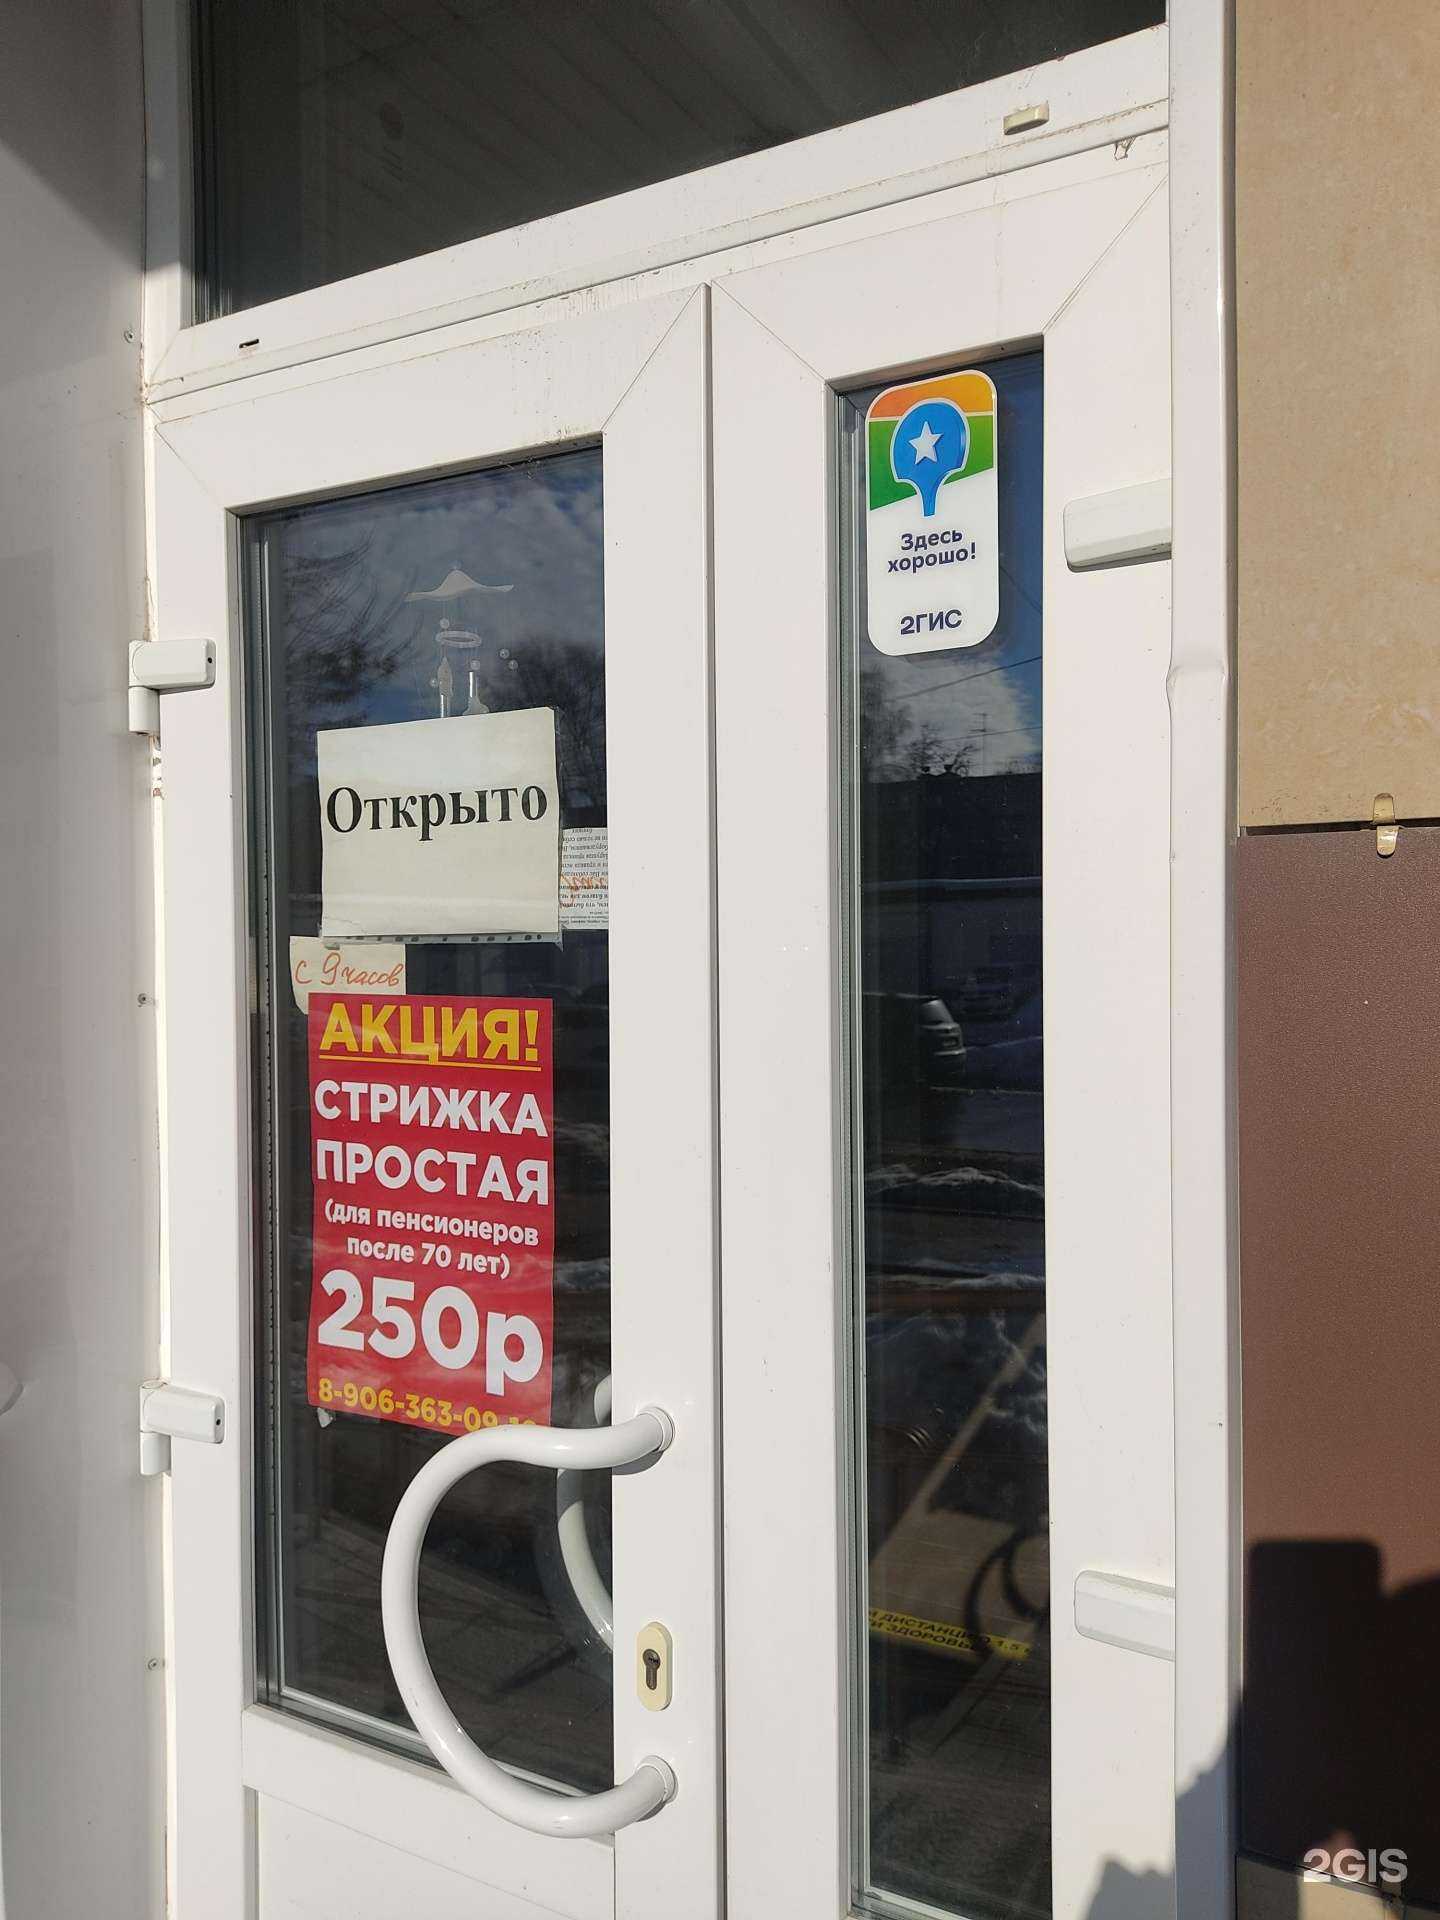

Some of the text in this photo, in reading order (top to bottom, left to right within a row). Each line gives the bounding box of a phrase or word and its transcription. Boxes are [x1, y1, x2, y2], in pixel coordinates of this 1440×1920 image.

[888, 542, 976, 573] хорошо!
[901, 529, 963, 552] Здесь
[900, 609, 962, 635] 2ГИС
[326, 785, 547, 841] Открыто
[320, 952, 340, 986] 9
[341, 963, 404, 987] часов
[319, 1003, 539, 1064] АКЦИЯ!
[314, 1080, 548, 1137] СТРИЖКА
[316, 1139, 549, 1206] ПРОСТАЯ
[324, 1199, 539, 1247] (для пенсионеров
[347, 1237, 511, 1280] после 70 лет)
[318, 1269, 544, 1397] 250р
